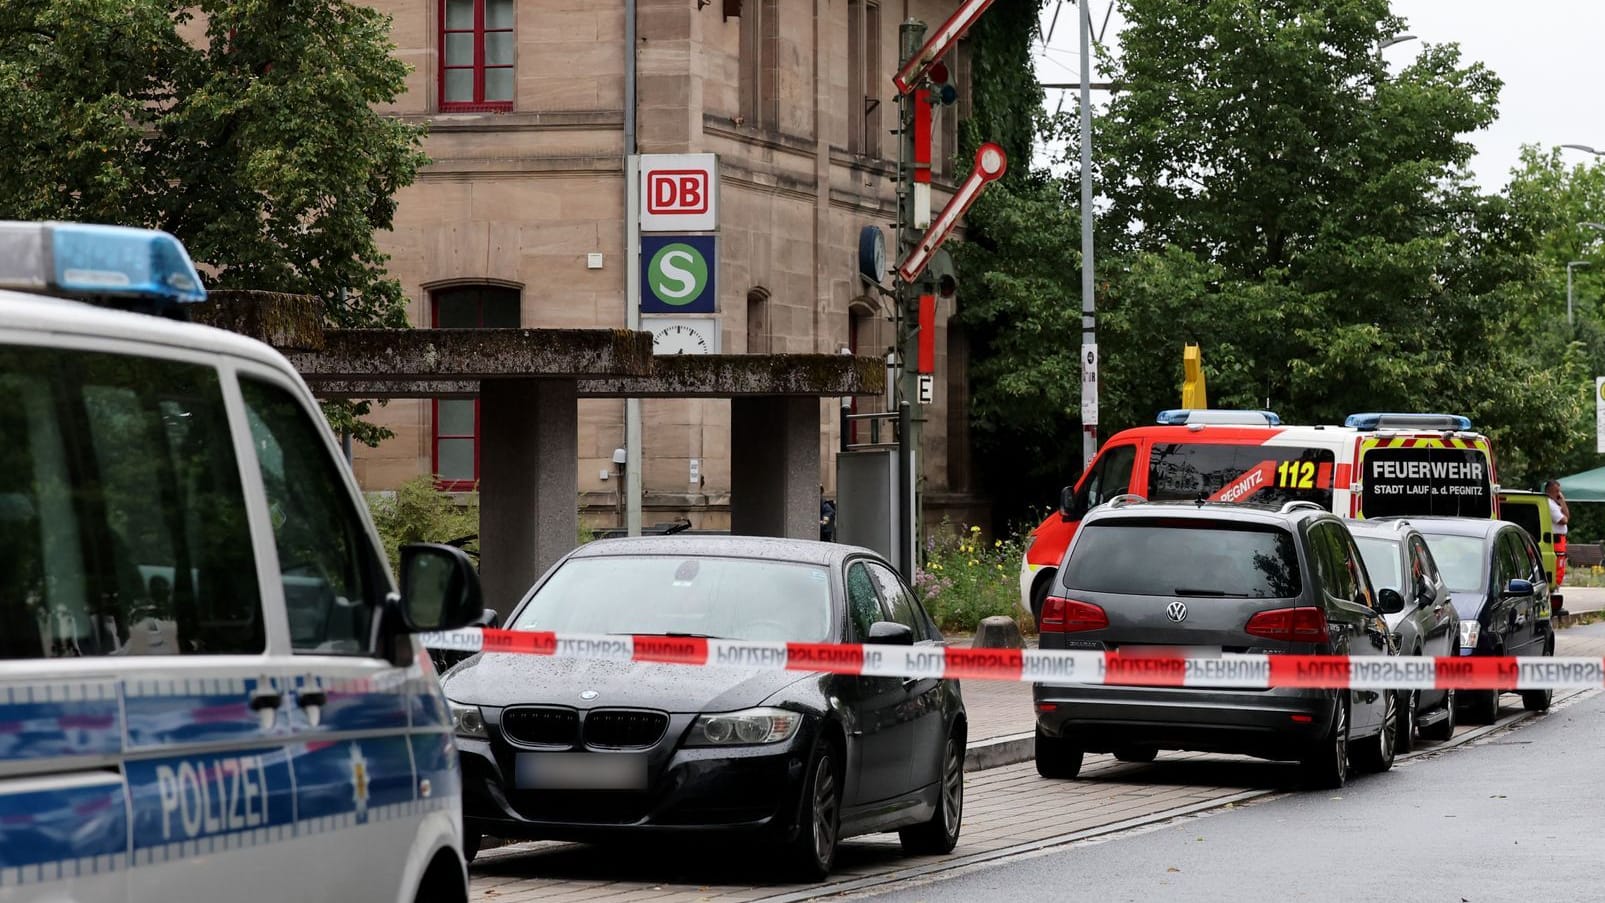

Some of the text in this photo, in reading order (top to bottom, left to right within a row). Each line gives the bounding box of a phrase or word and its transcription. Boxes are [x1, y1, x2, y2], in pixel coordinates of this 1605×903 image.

[655, 177, 701, 208] DB
[659, 250, 696, 298] S
[920, 378, 931, 402] E
[1220, 469, 1263, 502] PEGNITZ
[1278, 460, 1315, 489] 112
[1373, 461, 1482, 480] FEUERWEHR
[1374, 485, 1483, 496] STADT LAUF a. d. PEGNITZ
[156, 755, 268, 840] POLIZEI
